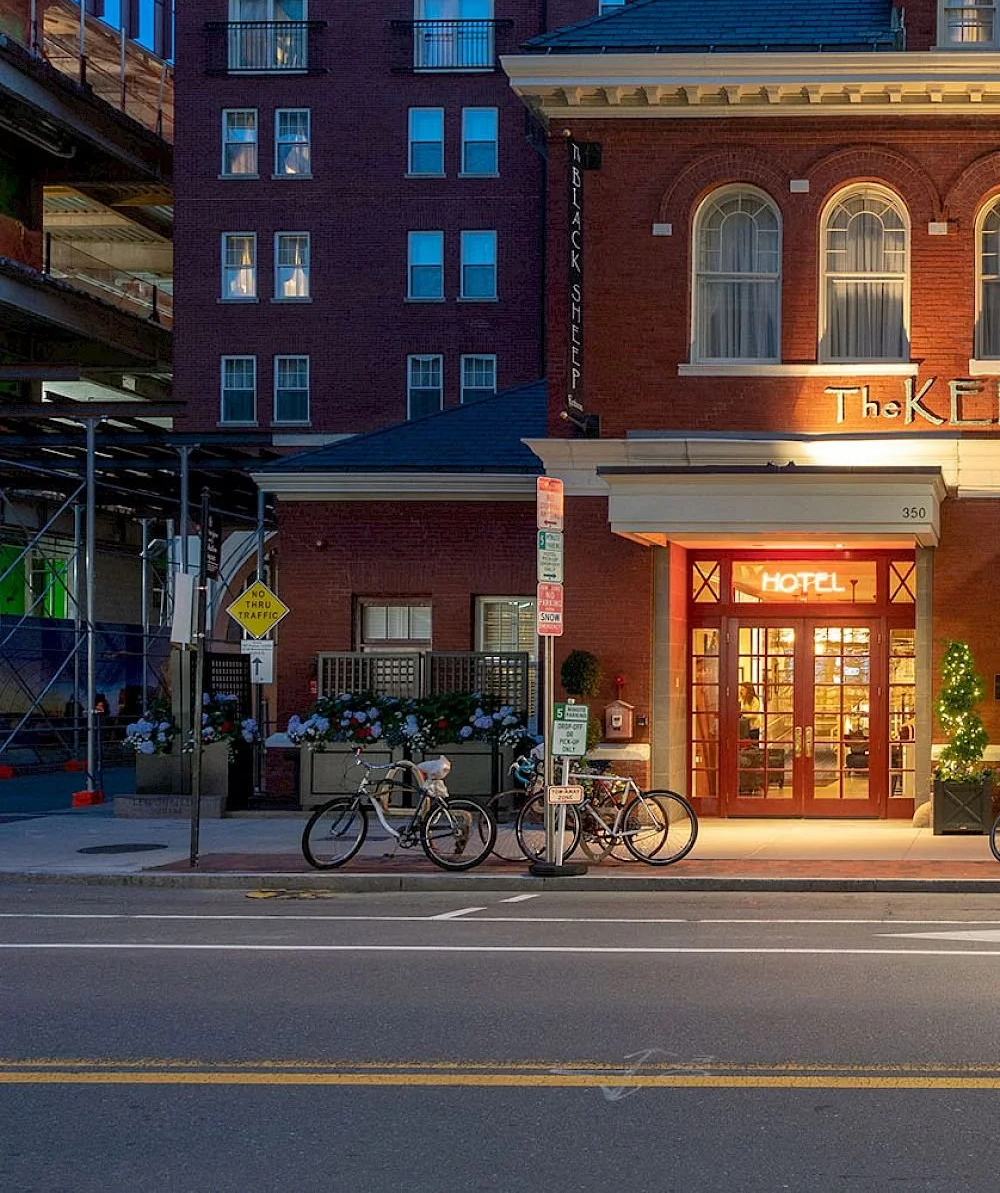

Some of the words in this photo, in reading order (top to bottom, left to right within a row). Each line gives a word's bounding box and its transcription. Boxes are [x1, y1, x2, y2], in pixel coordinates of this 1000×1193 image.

[571, 166, 581, 273] BLACK
[571, 283, 581, 390] SHEEP
[902, 507, 926, 519] 350
[761, 572, 846, 594] HOTEL
[541, 612, 560, 622] SNOW
[556, 707, 563, 719] 5
